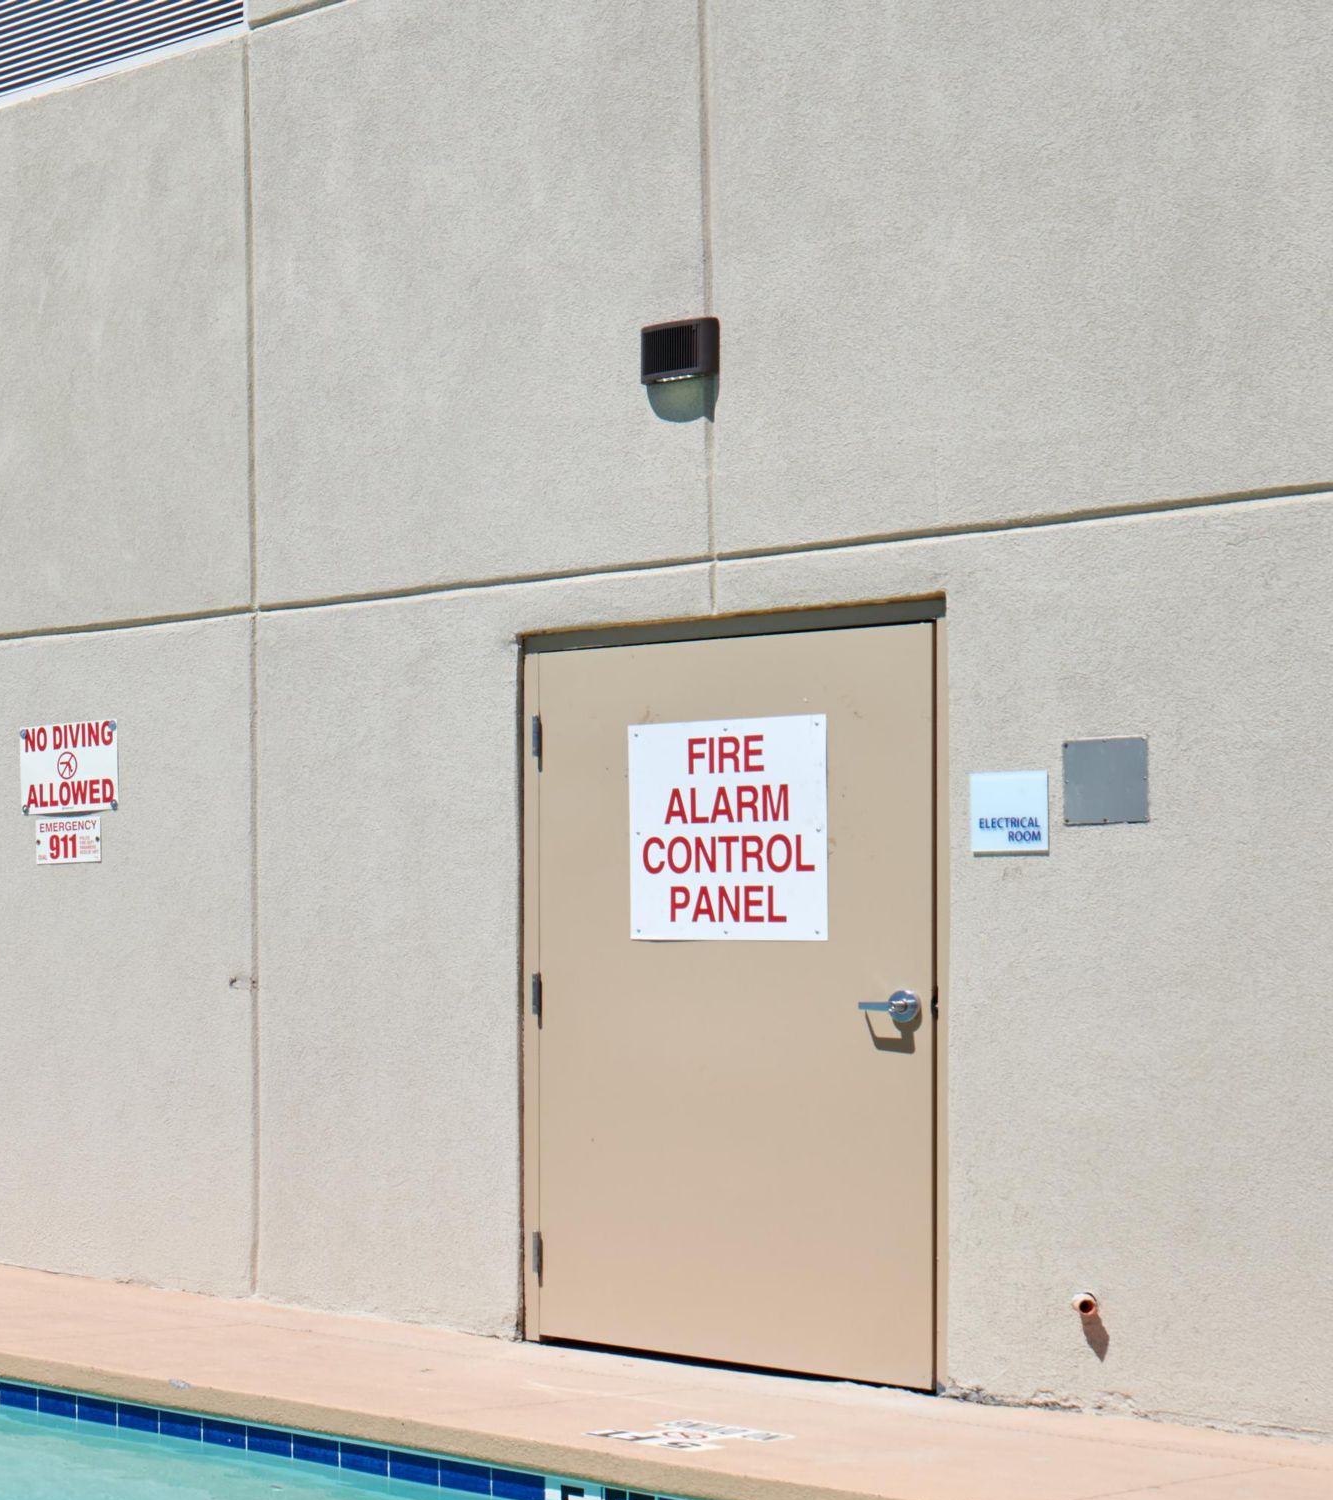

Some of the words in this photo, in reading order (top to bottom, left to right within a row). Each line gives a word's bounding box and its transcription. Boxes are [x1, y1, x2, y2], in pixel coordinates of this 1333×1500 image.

[25, 727, 47, 753] NO
[53, 720, 113, 750] DIVING
[688, 734, 764, 775] FIRE
[27, 778, 114, 808] ALLOWED
[664, 784, 789, 825] ALARM
[39, 819, 97, 833] EMERGENCY
[979, 816, 1040, 829] ELECTRICAL
[1008, 830, 1042, 842] ROOM
[49, 833, 77, 859] 911
[642, 833, 816, 875] CONTROL
[670, 885, 788, 923] PANEL
